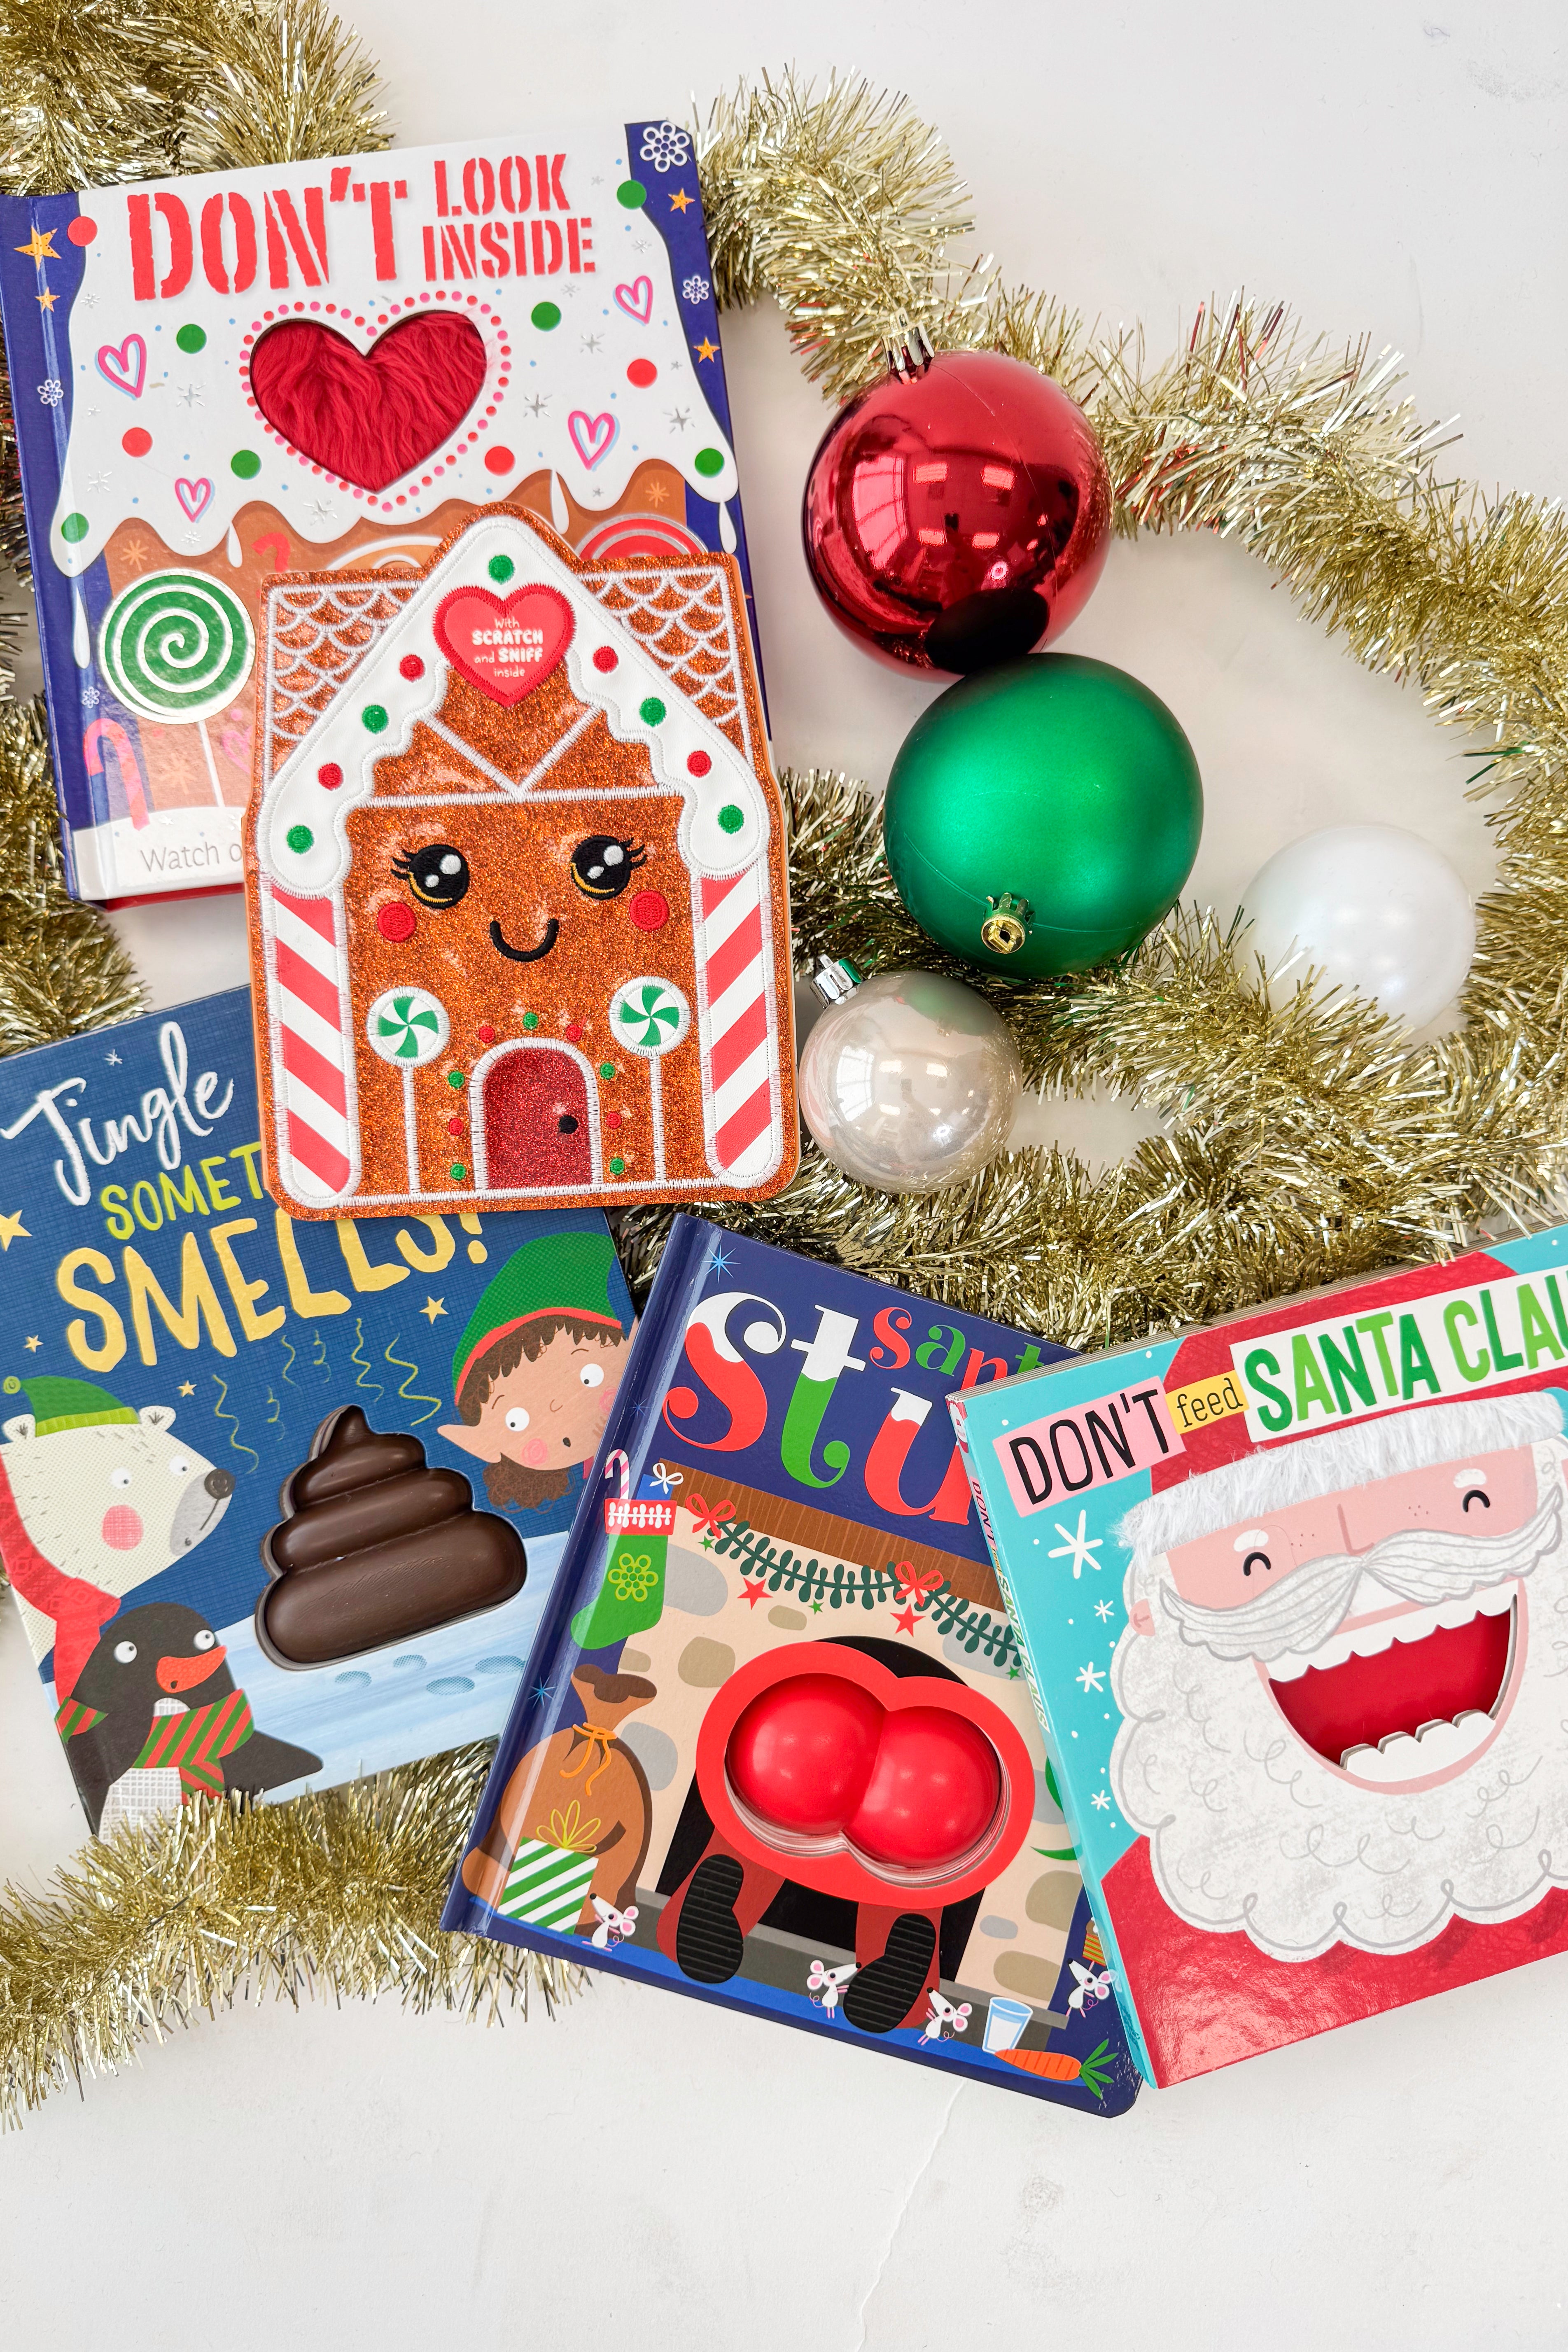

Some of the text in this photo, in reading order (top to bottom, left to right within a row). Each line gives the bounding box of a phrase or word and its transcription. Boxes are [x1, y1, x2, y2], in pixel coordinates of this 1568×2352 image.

[434, 153, 571, 218] LOOK
[127, 166, 408, 301] DON'T
[422, 217, 596, 282] INSIDE
[472, 629, 543, 645] SCRATCH
[474, 647, 543, 663] and SNIFF
[495, 616, 520, 629] With
[494, 665, 525, 678] inside
[140, 841, 220, 873] Watch
[0, 1021, 235, 1206] Jingle
[100, 1141, 264, 1240] SOMET
[1008, 1389, 1158, 1505] DON'T
[1176, 1377, 1243, 1428] feed
[1244, 1311, 1441, 1432] SANTA
[972, 1481, 996, 1547] DON'T
[999, 1575, 1025, 1647] SANTA
[1021, 1652, 1047, 1729] CLAUS
